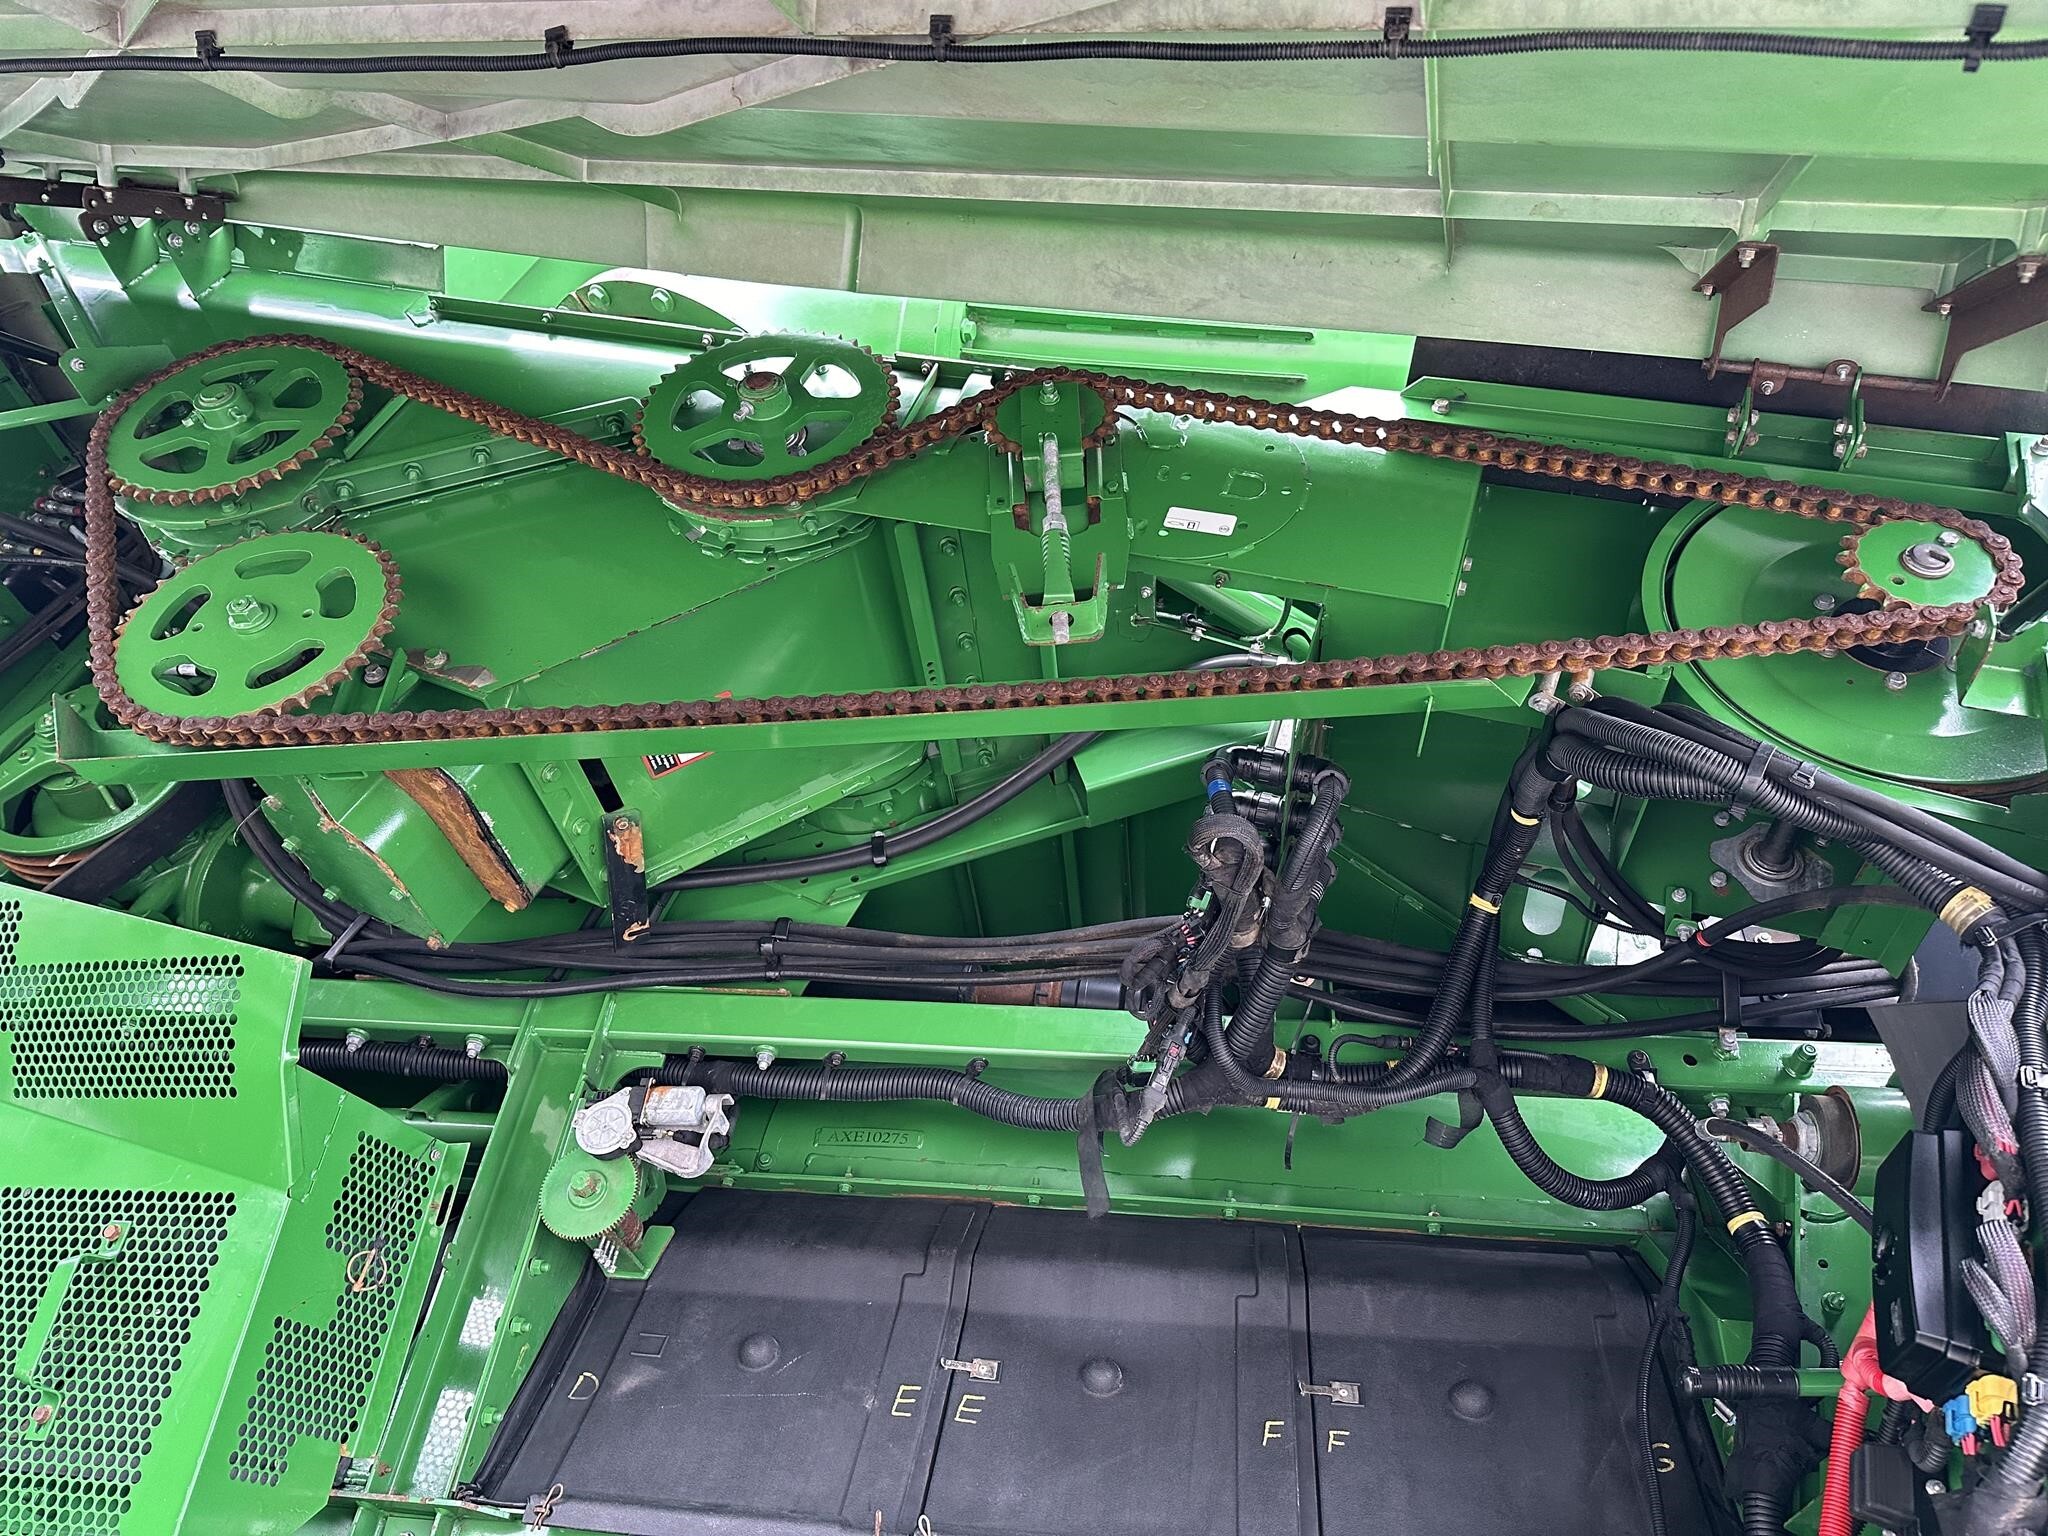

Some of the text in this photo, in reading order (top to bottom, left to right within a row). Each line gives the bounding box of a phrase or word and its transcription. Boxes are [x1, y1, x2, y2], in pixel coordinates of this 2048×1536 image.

[827, 1130, 910, 1145] AXE10275
[567, 1371, 600, 1400] D
[891, 1384, 922, 1417] E
[954, 1394, 986, 1424] E
[1262, 1420, 1285, 1446] F
[1327, 1430, 1350, 1453] F
